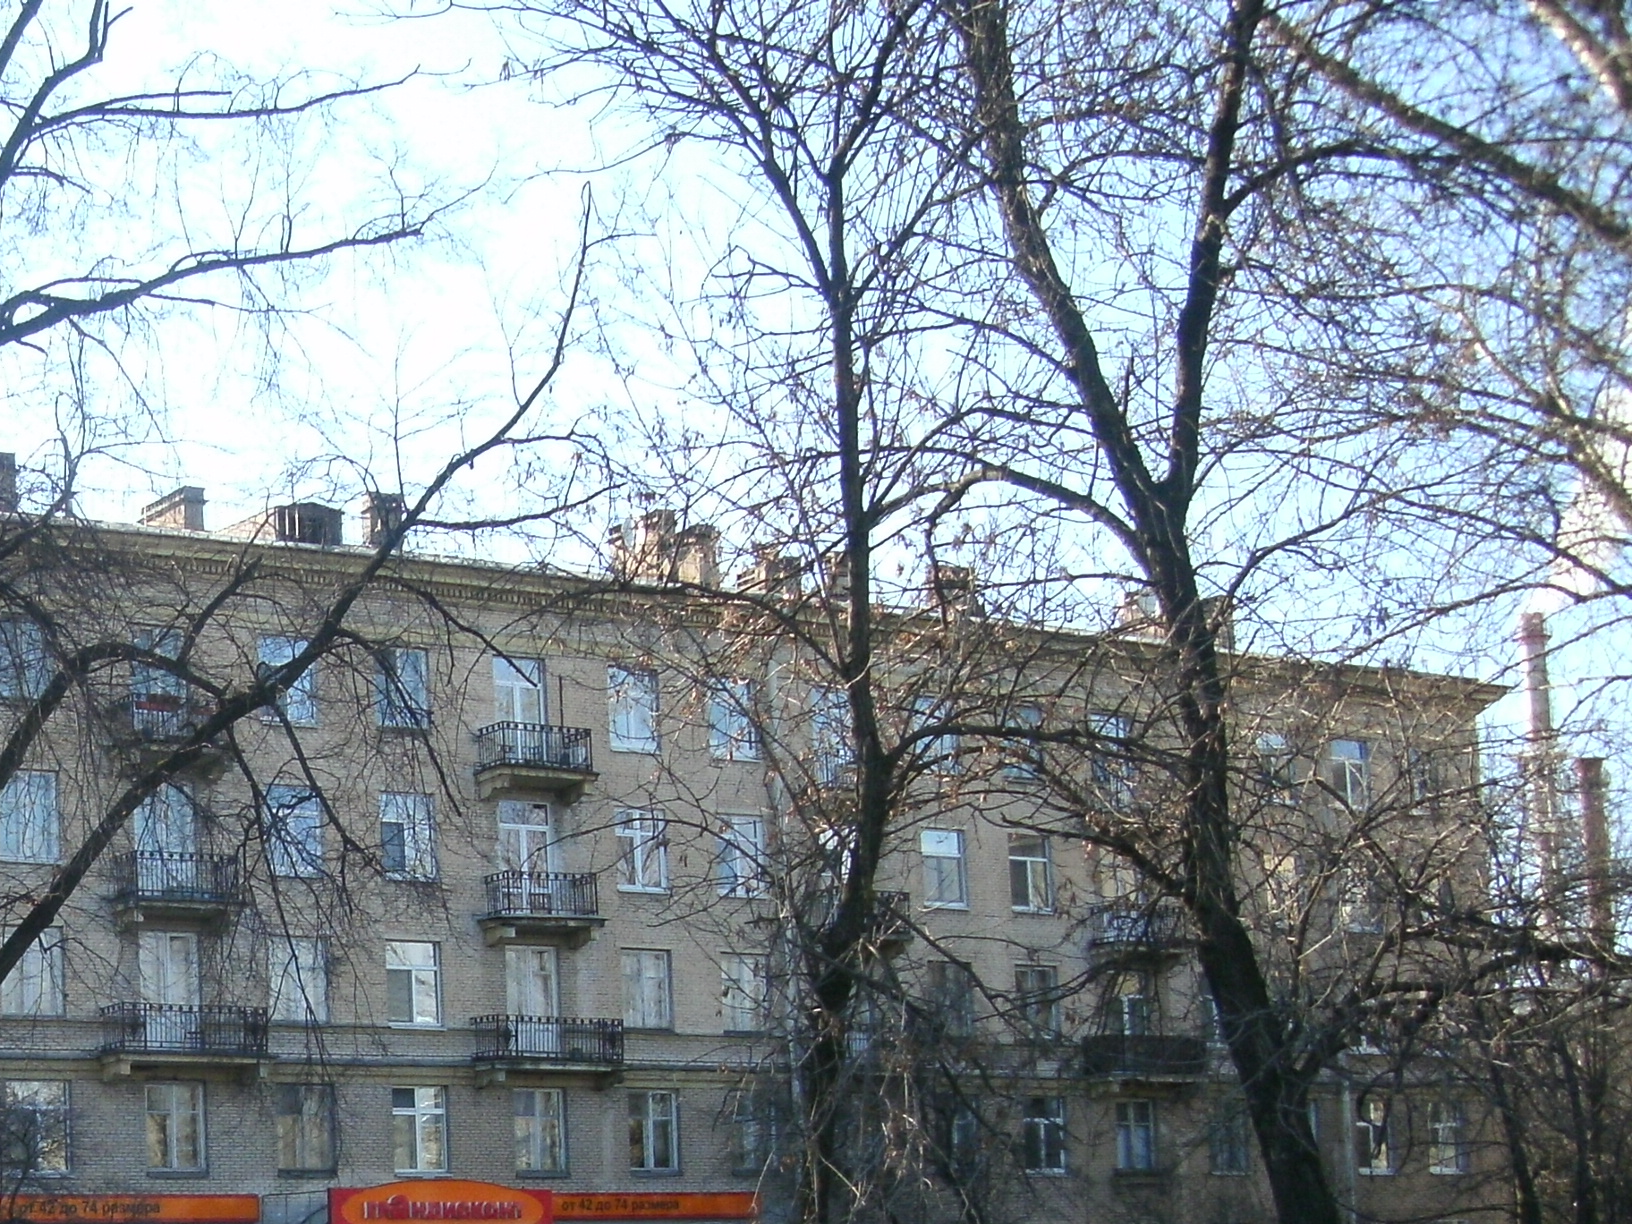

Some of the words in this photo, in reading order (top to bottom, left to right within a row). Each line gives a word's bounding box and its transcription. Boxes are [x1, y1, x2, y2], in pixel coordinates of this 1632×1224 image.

[82, 1200, 97, 1214] 74
[102, 1203, 160, 1218] размера
[562, 1201, 575, 1211] от
[579, 1199, 593, 1211] 42
[596, 1201, 611, 1212] до
[614, 1198, 628, 1210] 74
[631, 1200, 679, 1212] размера
